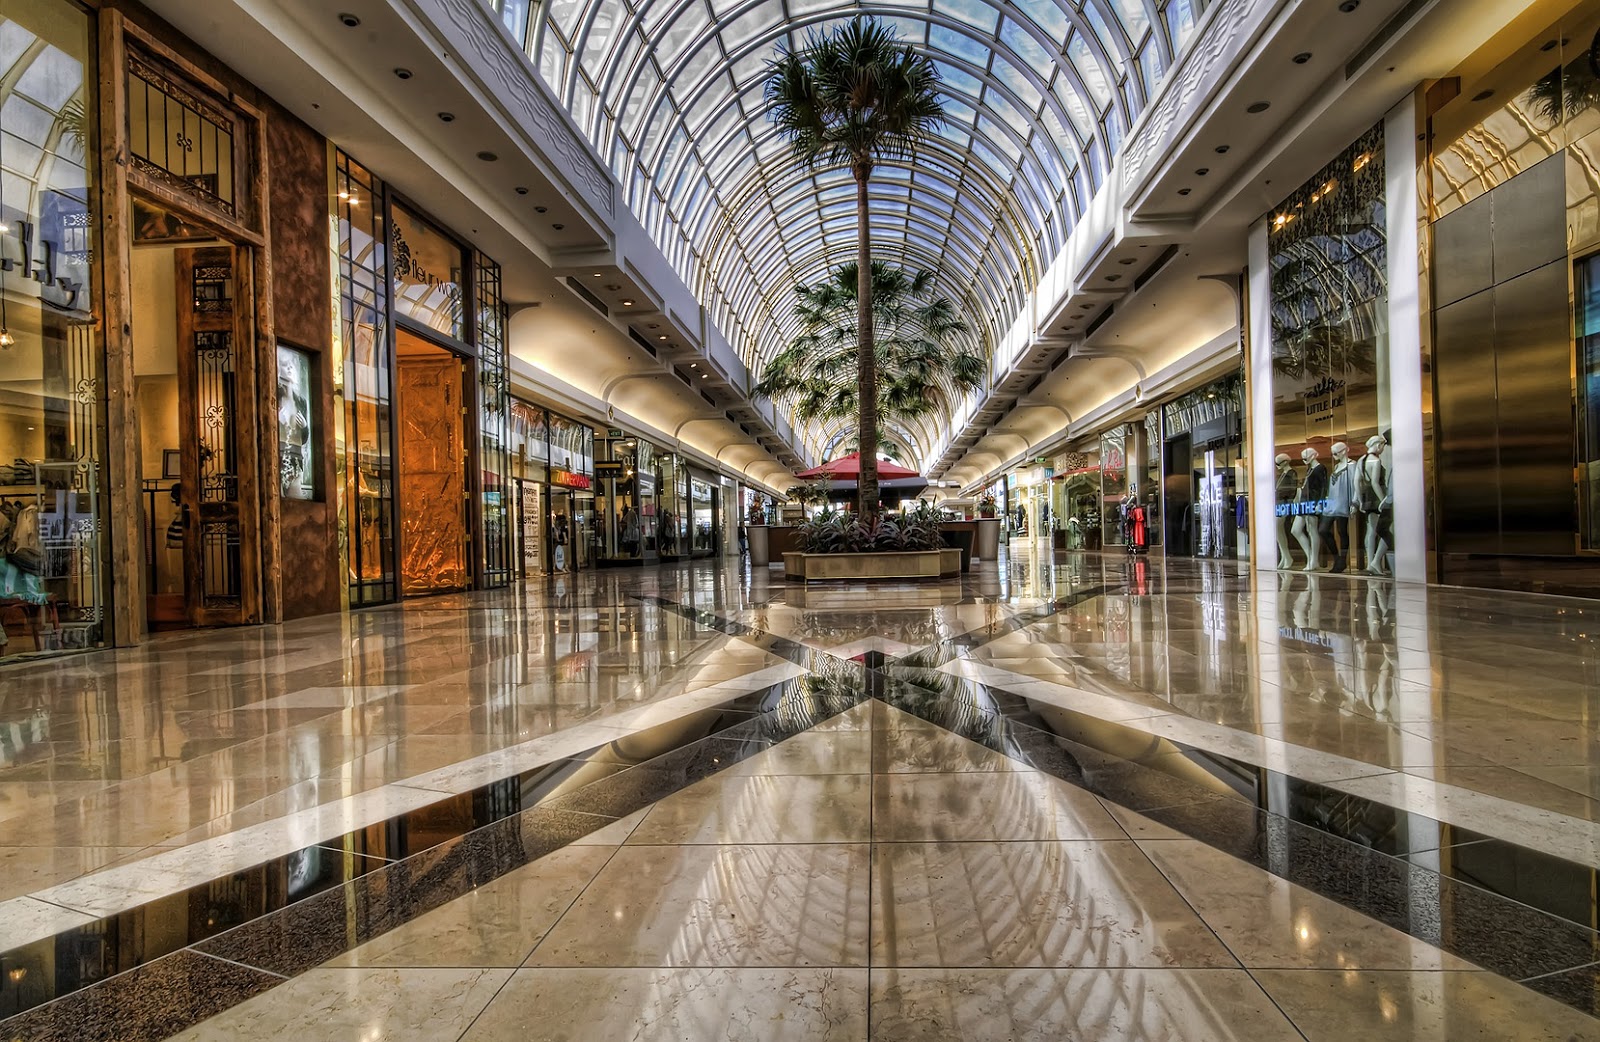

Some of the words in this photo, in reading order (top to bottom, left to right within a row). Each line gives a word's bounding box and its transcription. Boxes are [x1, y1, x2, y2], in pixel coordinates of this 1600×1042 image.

[1306, 399, 1328, 416] LITTLE
[1199, 487, 1223, 506] SALE
[1275, 503, 1290, 517] HOT
[1291, 502, 1299, 516] IN
[1300, 501, 1316, 515] THE
